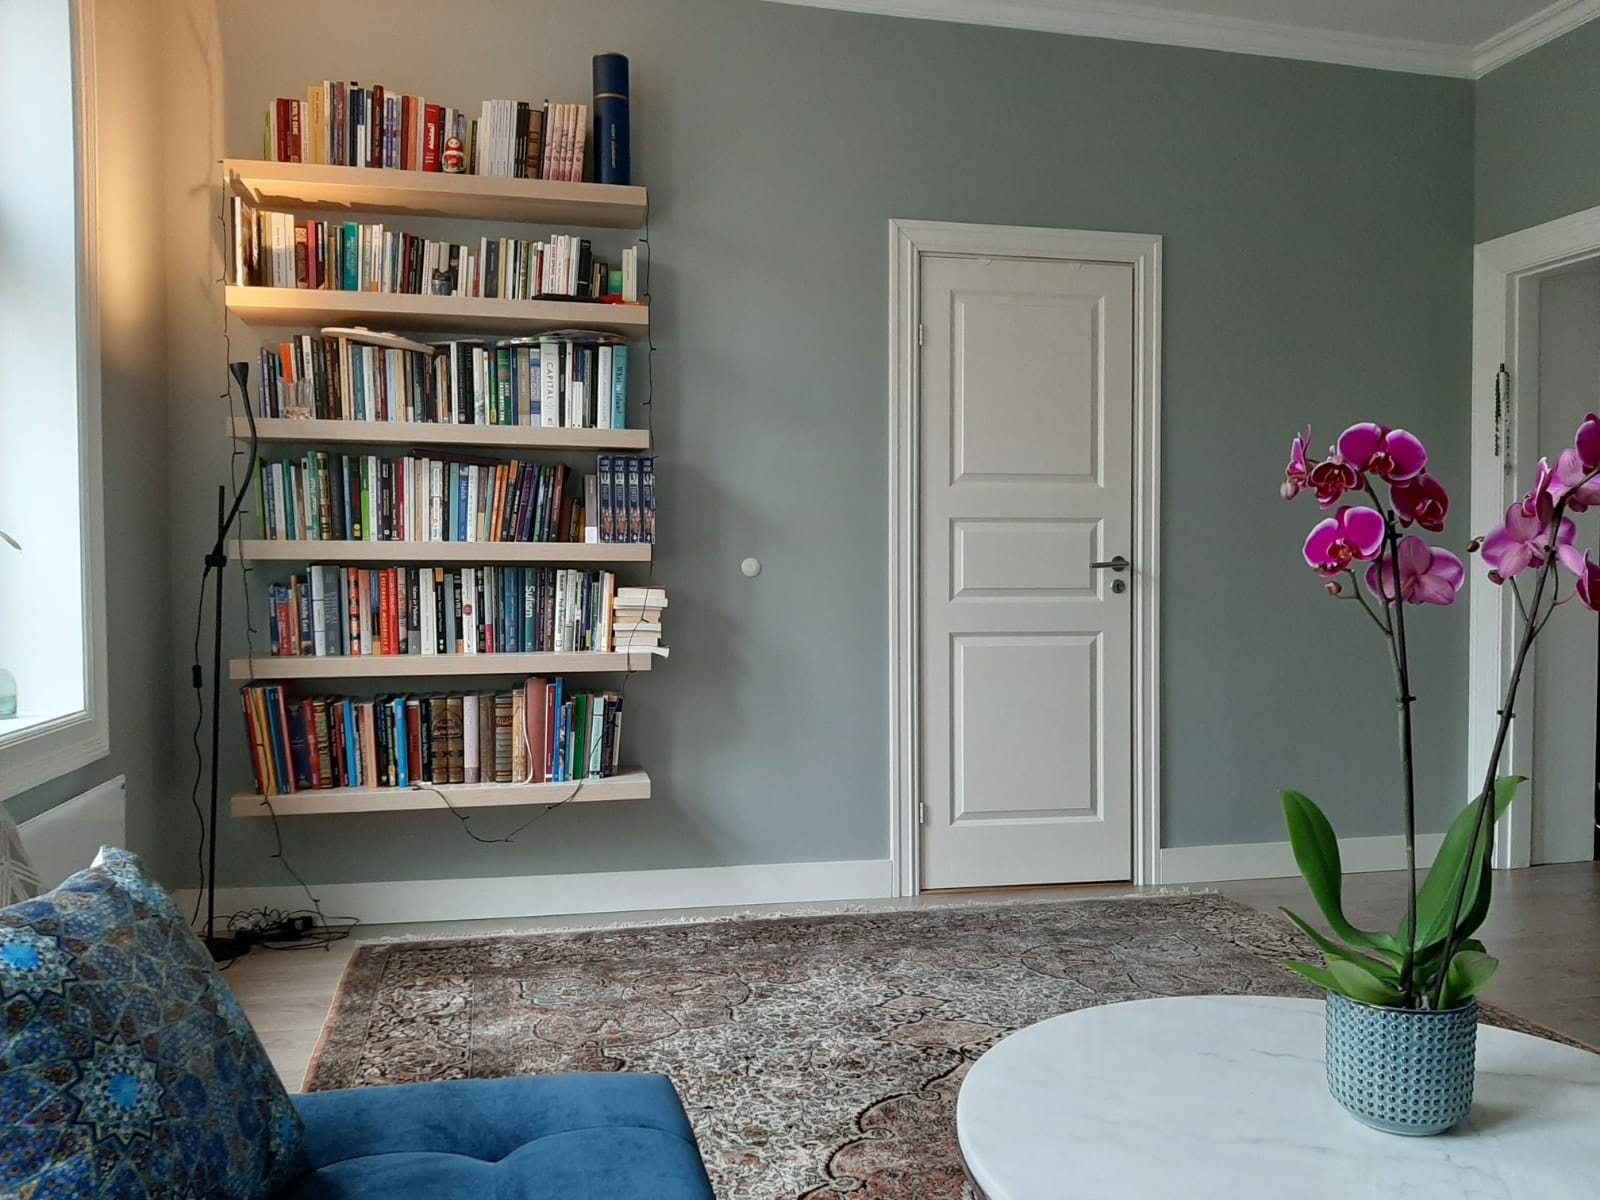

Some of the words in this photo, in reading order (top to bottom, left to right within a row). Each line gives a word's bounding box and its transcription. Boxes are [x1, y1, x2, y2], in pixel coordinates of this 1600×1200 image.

[546, 362, 554, 400] CAPITAL
[616, 366, 624, 383] What
[525, 585, 535, 618] Sufism
